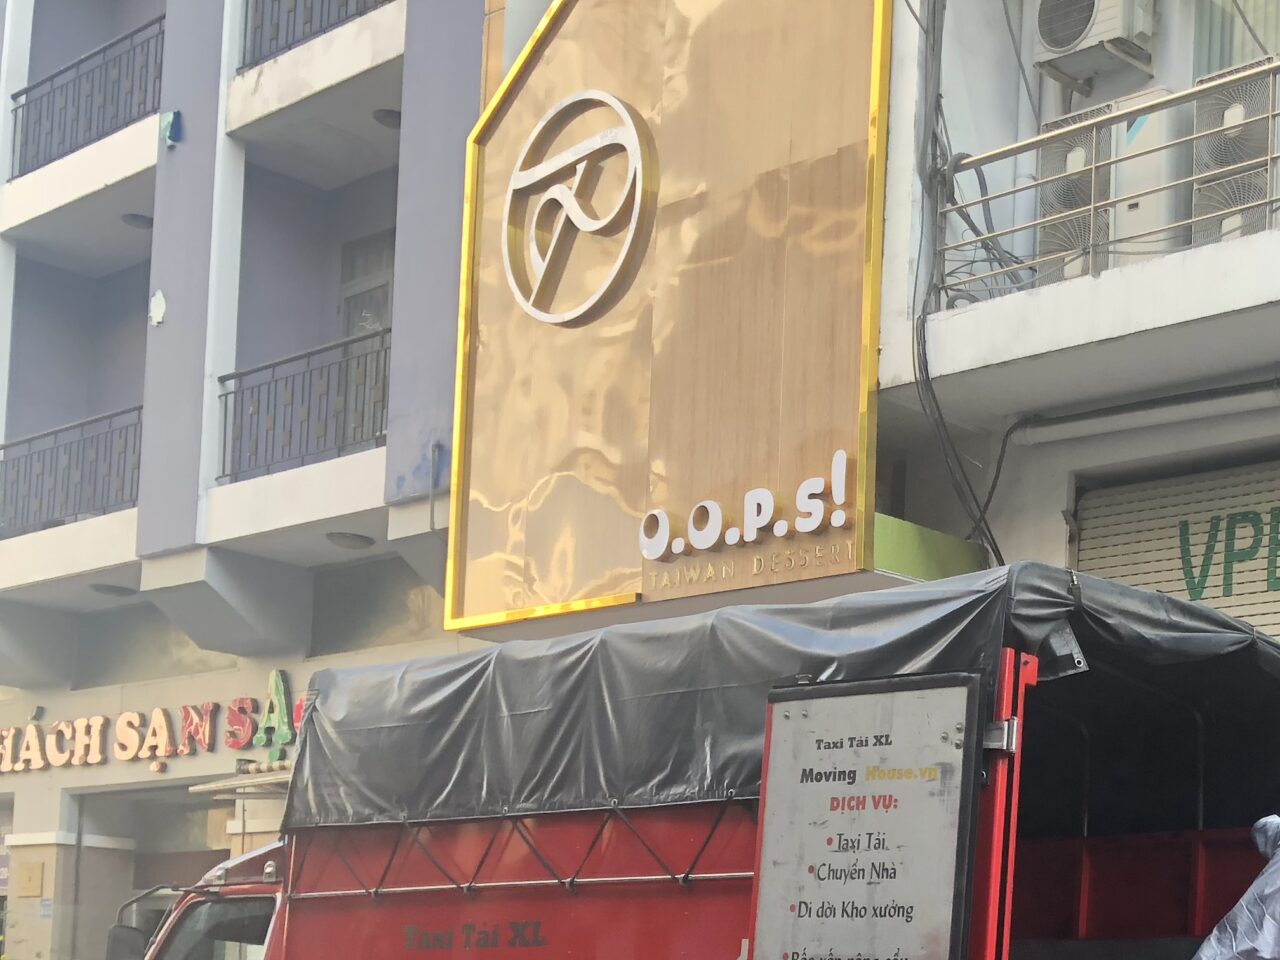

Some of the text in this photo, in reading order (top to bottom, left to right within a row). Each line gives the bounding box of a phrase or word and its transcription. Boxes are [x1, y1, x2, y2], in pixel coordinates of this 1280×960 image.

[650, 540, 854, 590] TAIWAN DESSERT
[113, 702, 217, 772] SẠN
[815, 738, 843, 750] Taxi
[873, 734, 892, 746] XL
[800, 768, 857, 785] Moving
[830, 795, 898, 814] DỊCH VỤ:
[837, 833, 860, 851] Taxi
[817, 859, 897, 885] Chuyển Nhà
[841, 901, 867, 919] Kho
[872, 900, 914, 922] xưởng
[508, 920, 546, 947] XL
